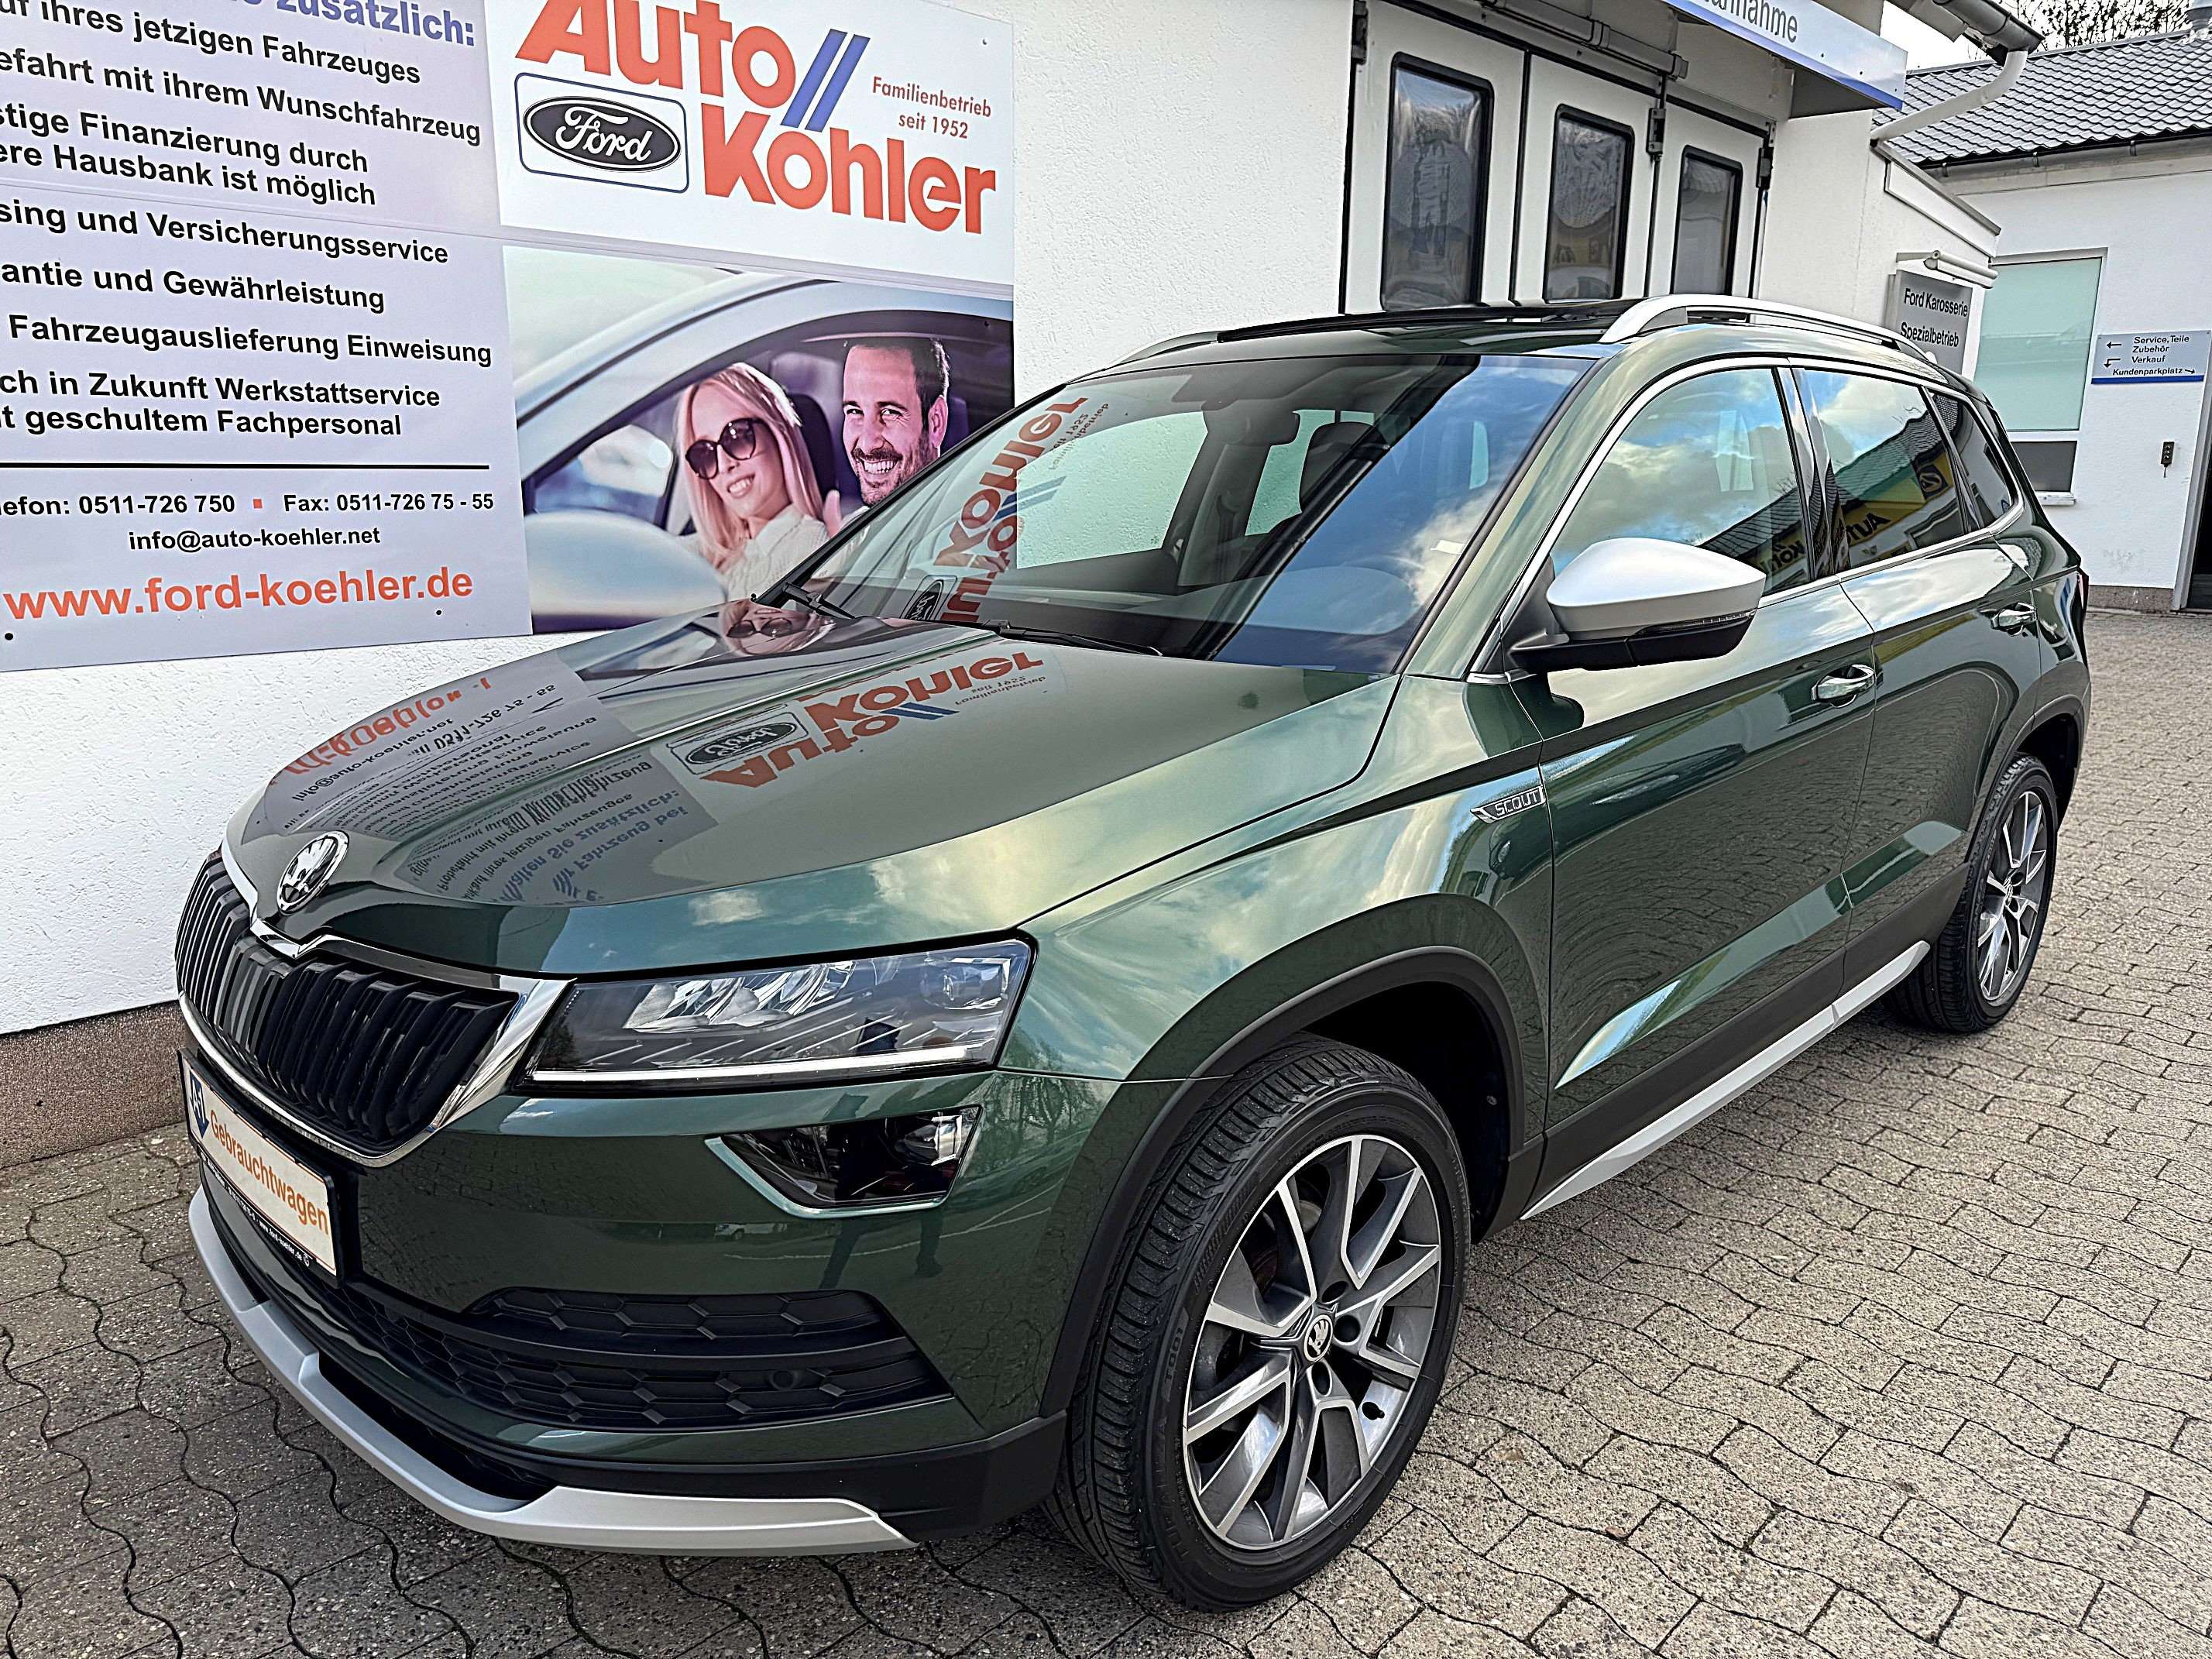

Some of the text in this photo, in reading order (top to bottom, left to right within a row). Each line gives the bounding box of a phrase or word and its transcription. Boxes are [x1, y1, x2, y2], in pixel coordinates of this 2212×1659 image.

[42, 0, 123, 33] ihres
[133, 12, 252, 55] jetzigen
[263, 35, 421, 84] Fahrzeuges
[515, 0, 796, 108] Auto
[104, 67, 154, 93] mit
[163, 71, 249, 107] ihrem
[256, 86, 480, 146] Wunschfahrzeug
[872, 76, 991, 117] Familienbetrieb
[0, 102, 368, 172] tige Finanzierung durch
[555, 105, 652, 163] Ford
[898, 112, 968, 139] seit 1952
[53, 144, 213, 186] Hausbank
[222, 166, 259, 191] ist
[266, 174, 376, 205] möglich
[77, 211, 138, 234] und
[146, 212, 448, 263] Versicherungsservice
[2, 261, 384, 314] antie und Gewährleistung
[1905, 287, 1968, 318] Ford Karosserie
[9, 314, 492, 367] Fahrzeugauslieferung Einweisung
[1901, 321, 1960, 348] Spezialbetrieb
[2112, 367, 2183, 376] Kundenparkplatz
[2131, 355, 2166, 363] Verkauf
[0, 370, 440, 407] ch in Zukunft Werkstattservice
[25, 407, 208, 435] geschultem
[218, 410, 401, 438] Fachpersonal
[79, 495, 187, 515] 0511-726
[194, 494, 235, 513] 750
[283, 495, 329, 512] Fax:
[337, 493, 425, 511] 0511-726
[431, 493, 454, 510] 75
[472, 493, 494, 510] 55
[129, 527, 380, 553] info@auto-koehler.net
[2, 566, 473, 620] www.ford-koehler.de
[1495, 789, 1540, 816] SCOUT
[210, 1109, 329, 1236] Gebrauchtwagen
